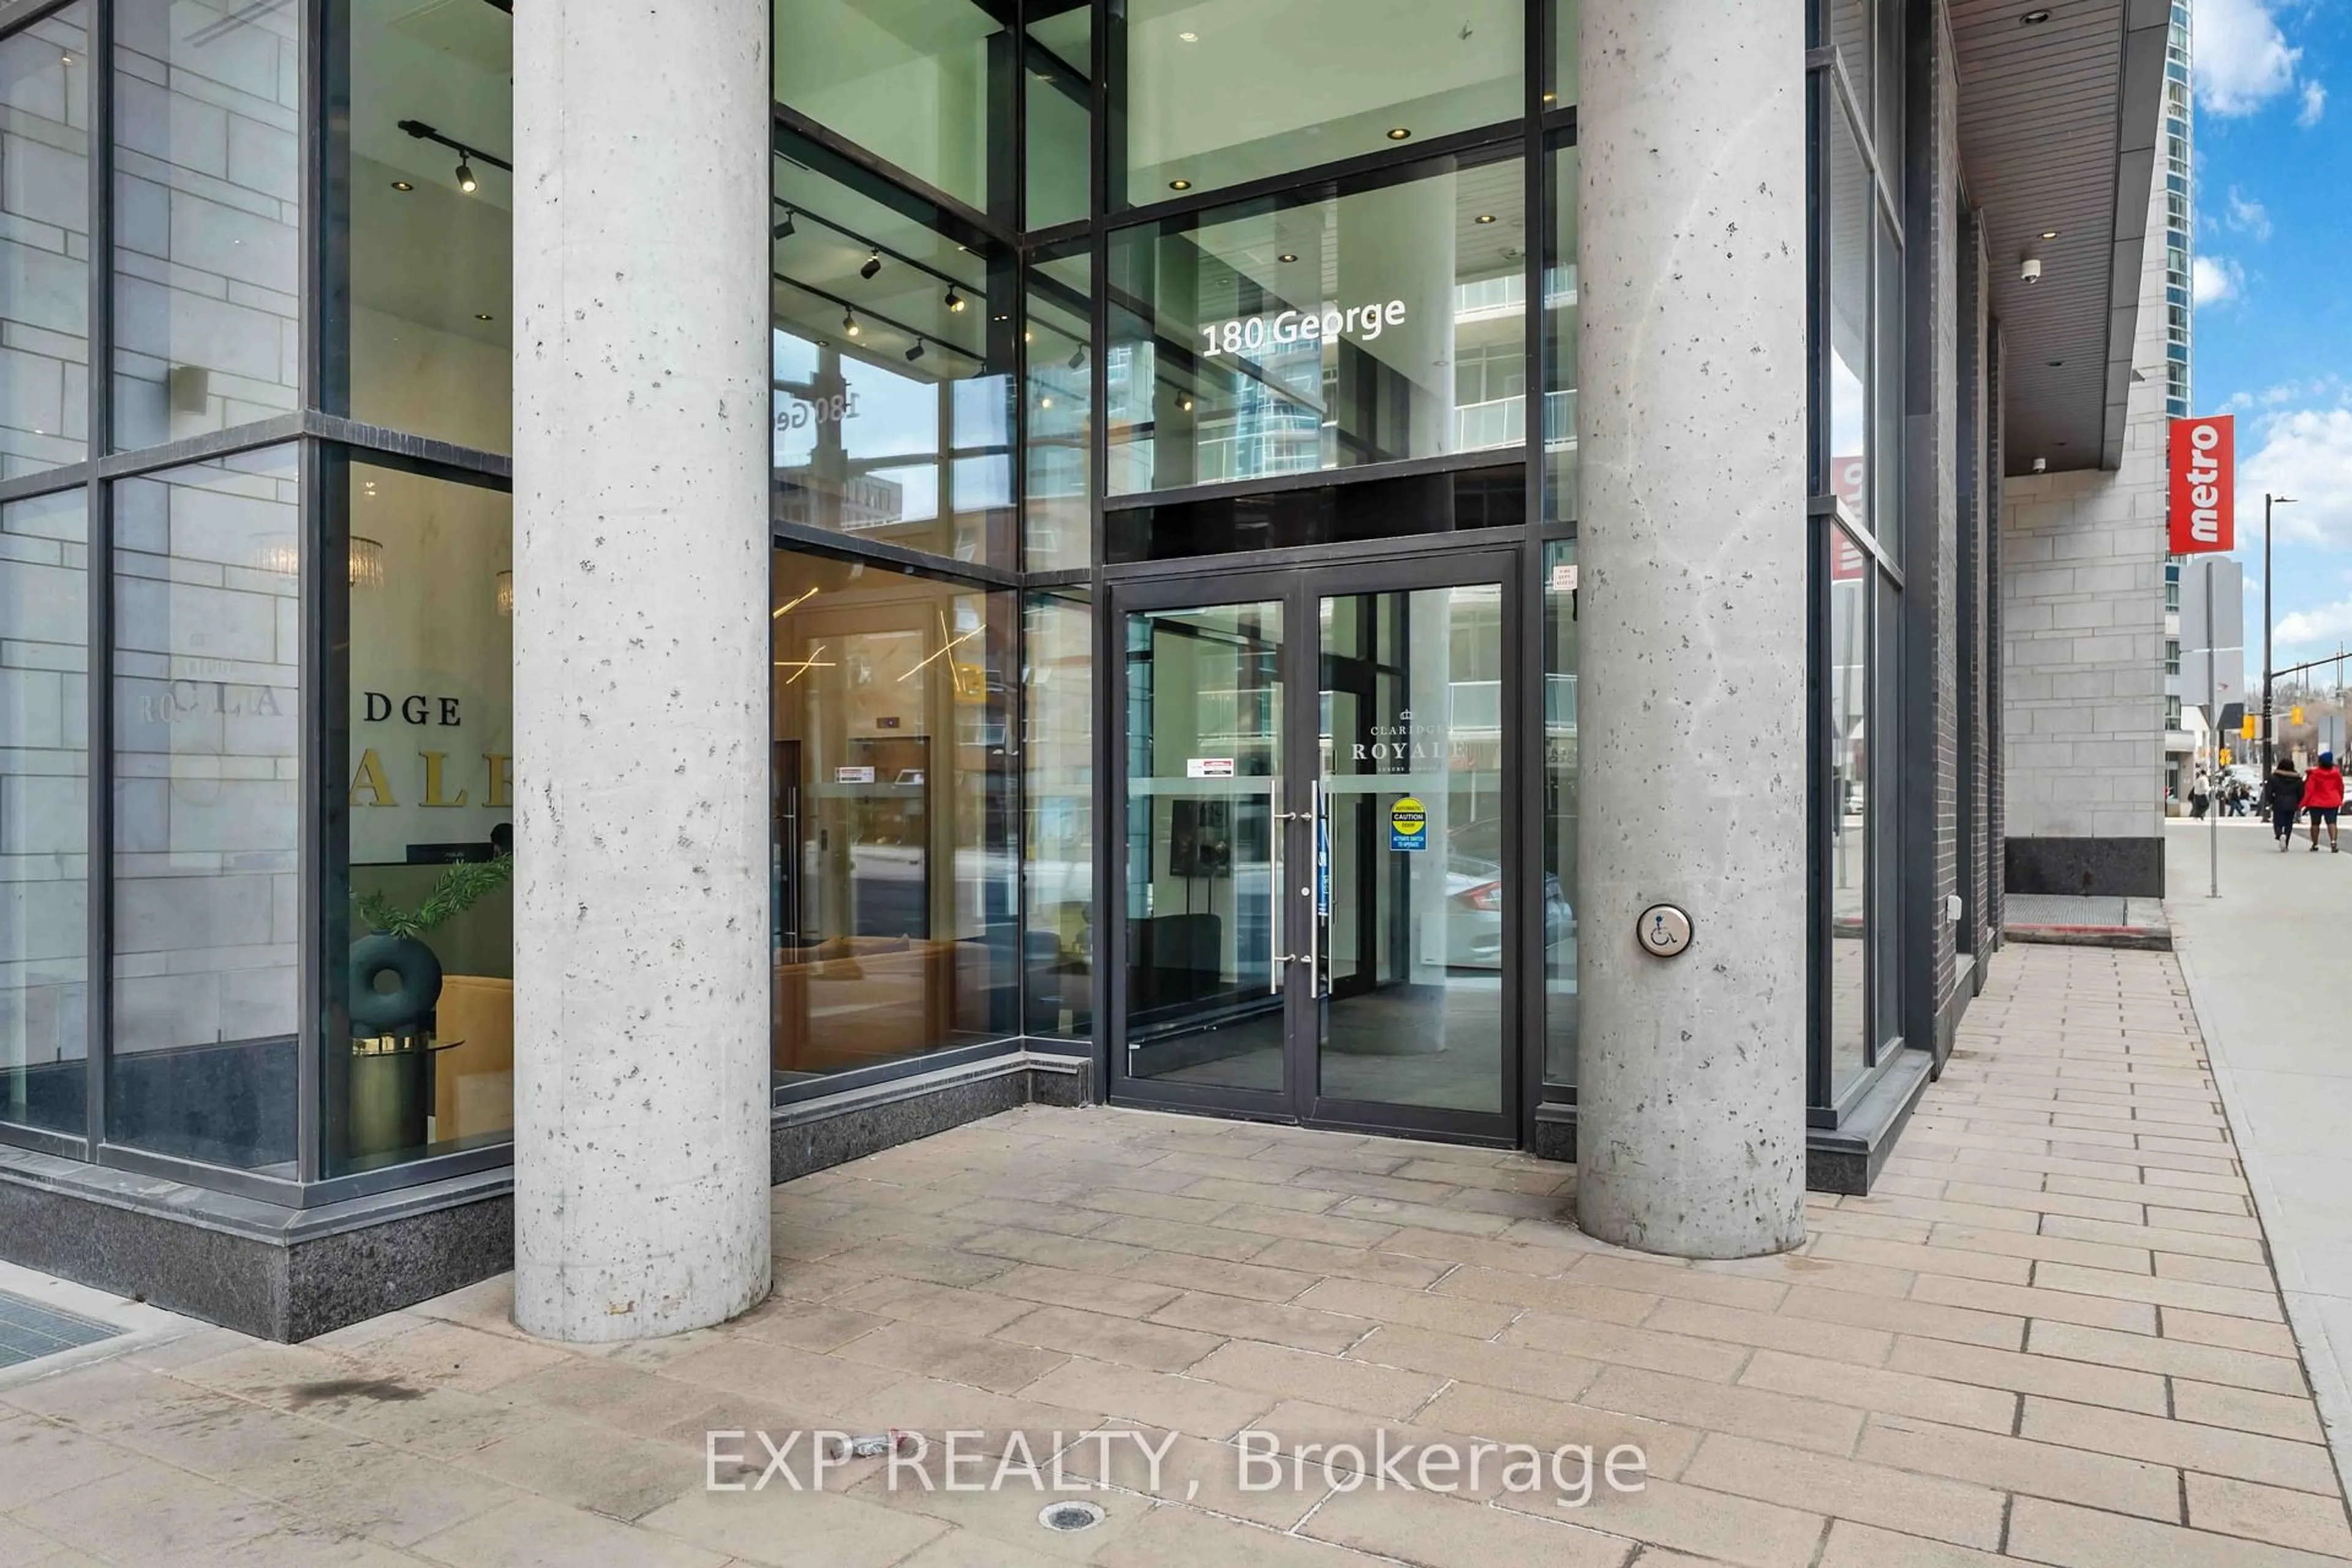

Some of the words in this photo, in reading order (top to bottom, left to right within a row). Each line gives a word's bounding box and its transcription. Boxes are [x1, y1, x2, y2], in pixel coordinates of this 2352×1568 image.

[1202, 315, 1264, 358] 180
[1273, 299, 1406, 341] George
[2185, 424, 2218, 543] metro
[1351, 740, 1466, 760] ROYALE
